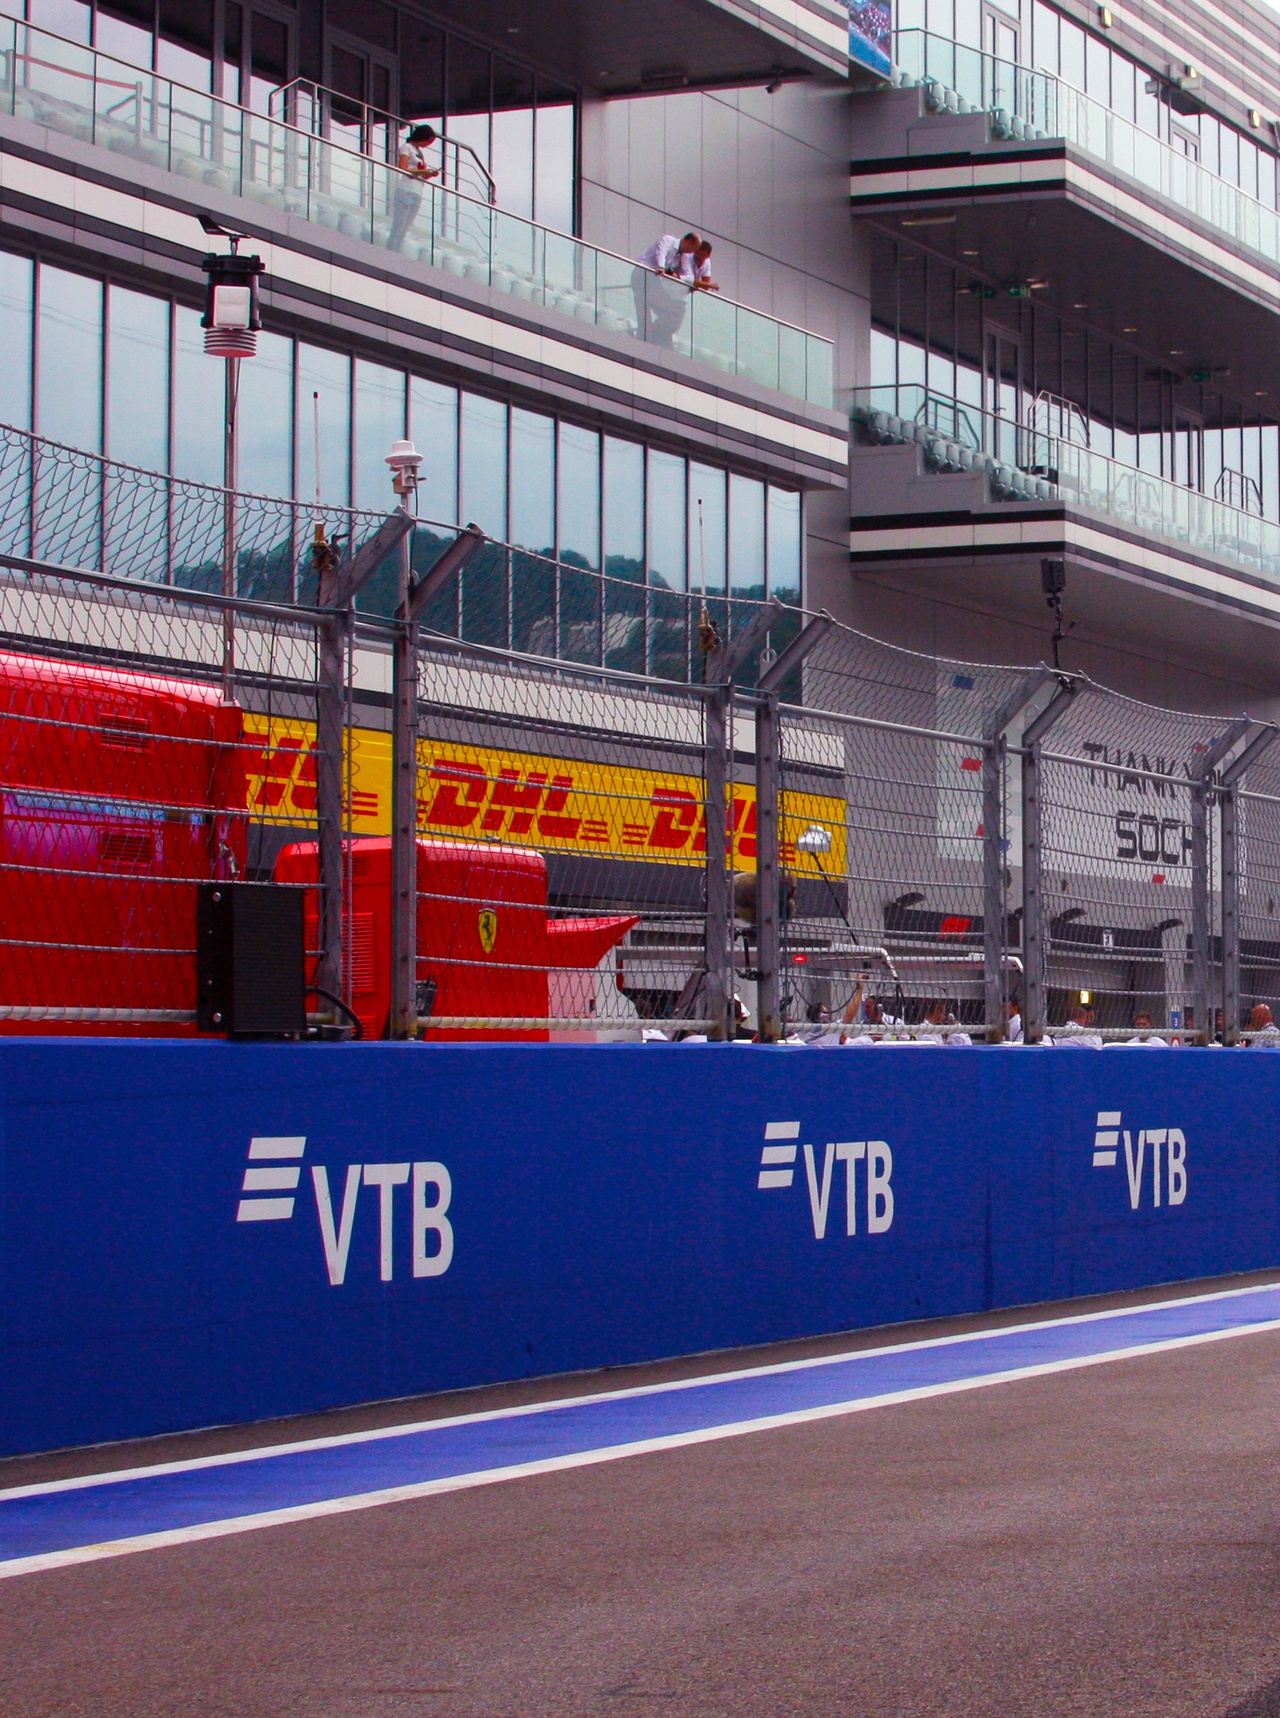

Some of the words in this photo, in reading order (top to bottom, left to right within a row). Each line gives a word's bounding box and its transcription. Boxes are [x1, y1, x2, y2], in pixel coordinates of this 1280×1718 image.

[427, 759, 582, 839] DHL
[1083, 742, 1176, 799] THANK
[1115, 810, 1193, 866] SOCH
[803, 1141, 893, 1239] VTB
[1123, 1128, 1187, 1209] VTB
[312, 1161, 454, 1285] VTB
